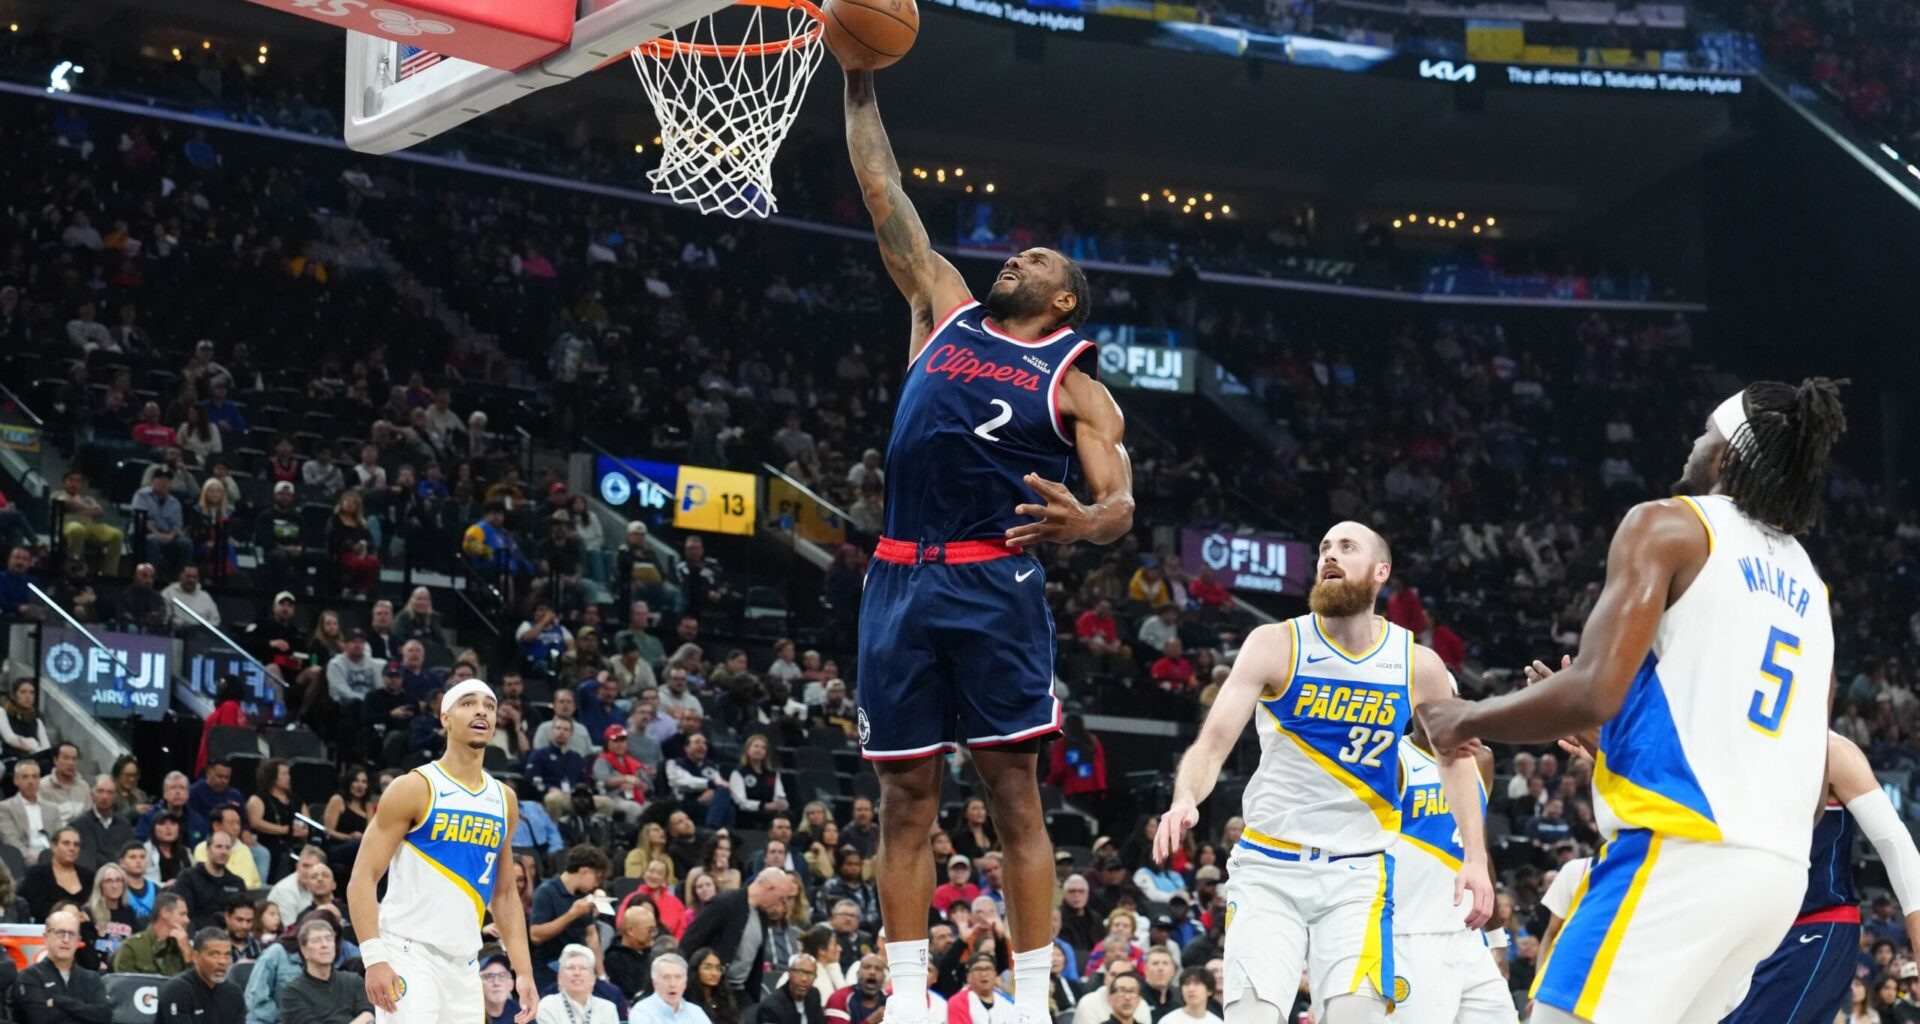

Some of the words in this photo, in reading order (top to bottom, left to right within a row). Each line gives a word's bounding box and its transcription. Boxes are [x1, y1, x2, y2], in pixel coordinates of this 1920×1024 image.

[1506, 66, 1533, 84] The
[1534, 68, 1580, 86] all-new
[1580, 70, 1603, 88] Kia
[1603, 71, 1657, 90] Telluride
[1658, 73, 1742, 96] Turbo-Hybrid
[926, 344, 1040, 391] Clippers
[1127, 346, 1182, 378] FIJI
[974, 398, 1013, 442] 2
[636, 480, 666, 509] 14
[721, 492, 745, 516] 13
[1231, 538, 1287, 577] FIJI
[1738, 556, 1810, 618] WALKER
[87, 646, 166, 689] FIJI
[1747, 625, 1802, 739] 5
[91, 688, 159, 708] AIRWAYS
[1293, 683, 1400, 726] PACERS
[1338, 725, 1395, 769] 32
[1411, 787, 1451, 819] PAC
[430, 812, 502, 849] PACERS
[477, 851, 497, 885] 2
